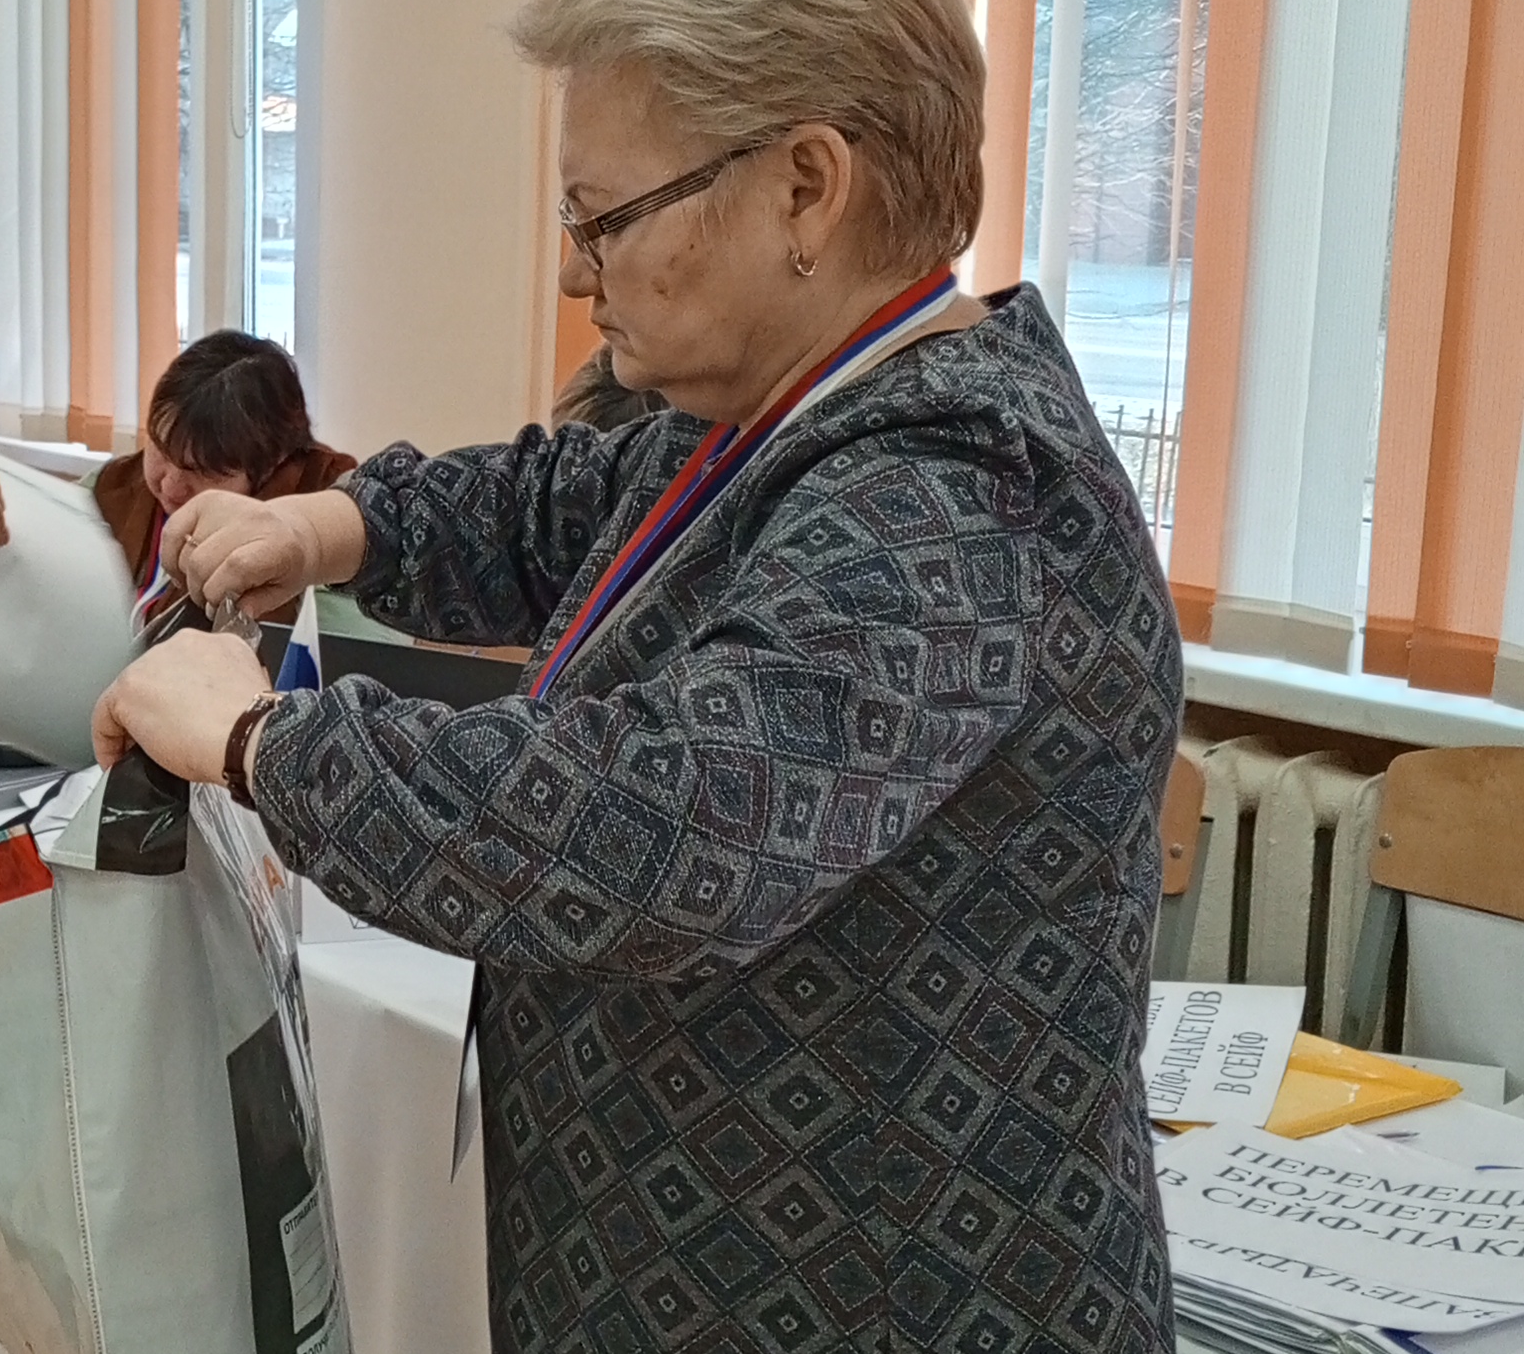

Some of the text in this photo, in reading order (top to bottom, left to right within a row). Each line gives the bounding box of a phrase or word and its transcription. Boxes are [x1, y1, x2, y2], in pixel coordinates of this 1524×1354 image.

[1214, 1031, 1268, 1095] В СЕЙФ
[1226, 1144, 1524, 1208] ПЕРЕМЕЩ
[1202, 1187, 1524, 1257] СЕЙФ-ПАК
